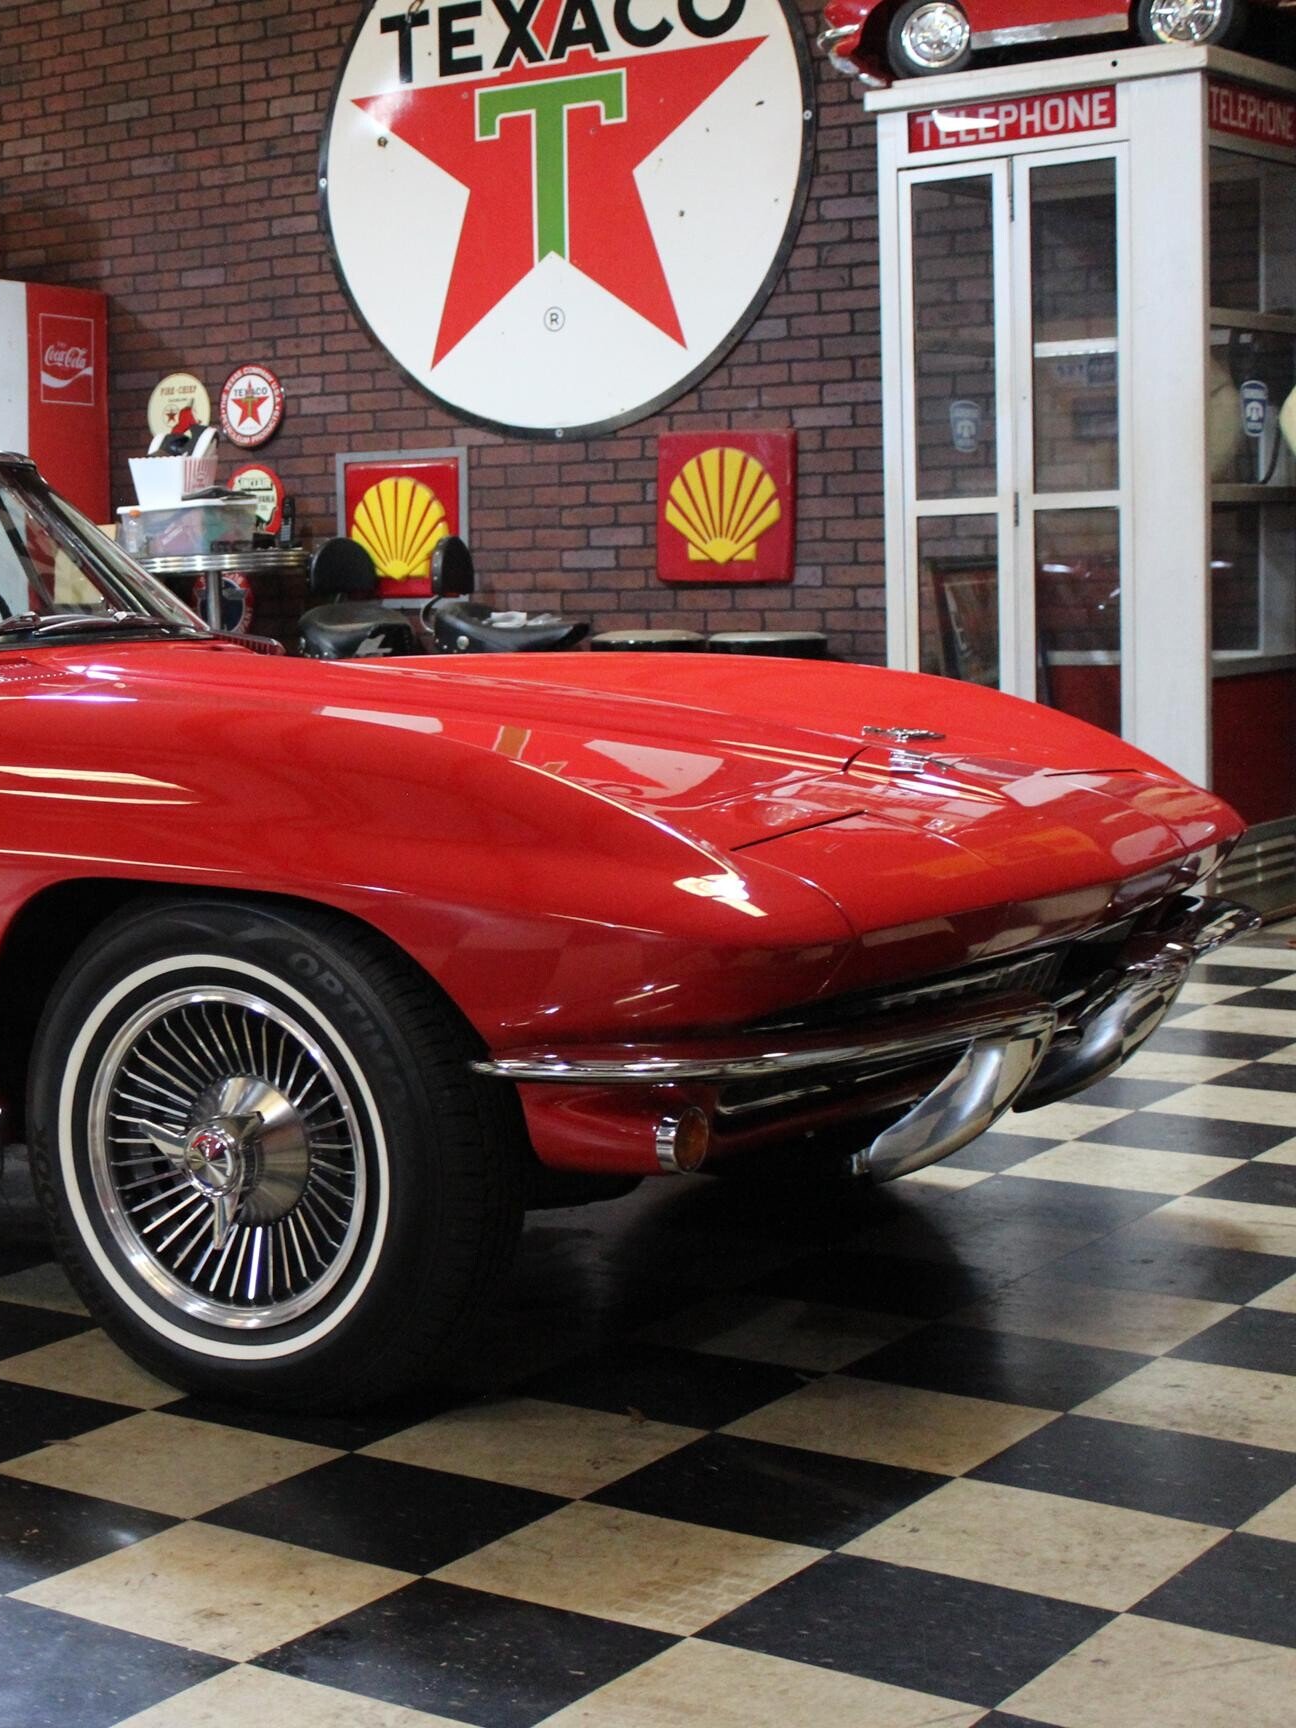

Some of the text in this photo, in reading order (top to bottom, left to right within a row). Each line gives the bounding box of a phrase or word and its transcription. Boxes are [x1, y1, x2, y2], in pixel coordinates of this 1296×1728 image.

[380, 0, 746, 83] TEXACO
[916, 91, 1111, 148] TELEPHONE
[1209, 86, 1296, 141] TELEPHONE
